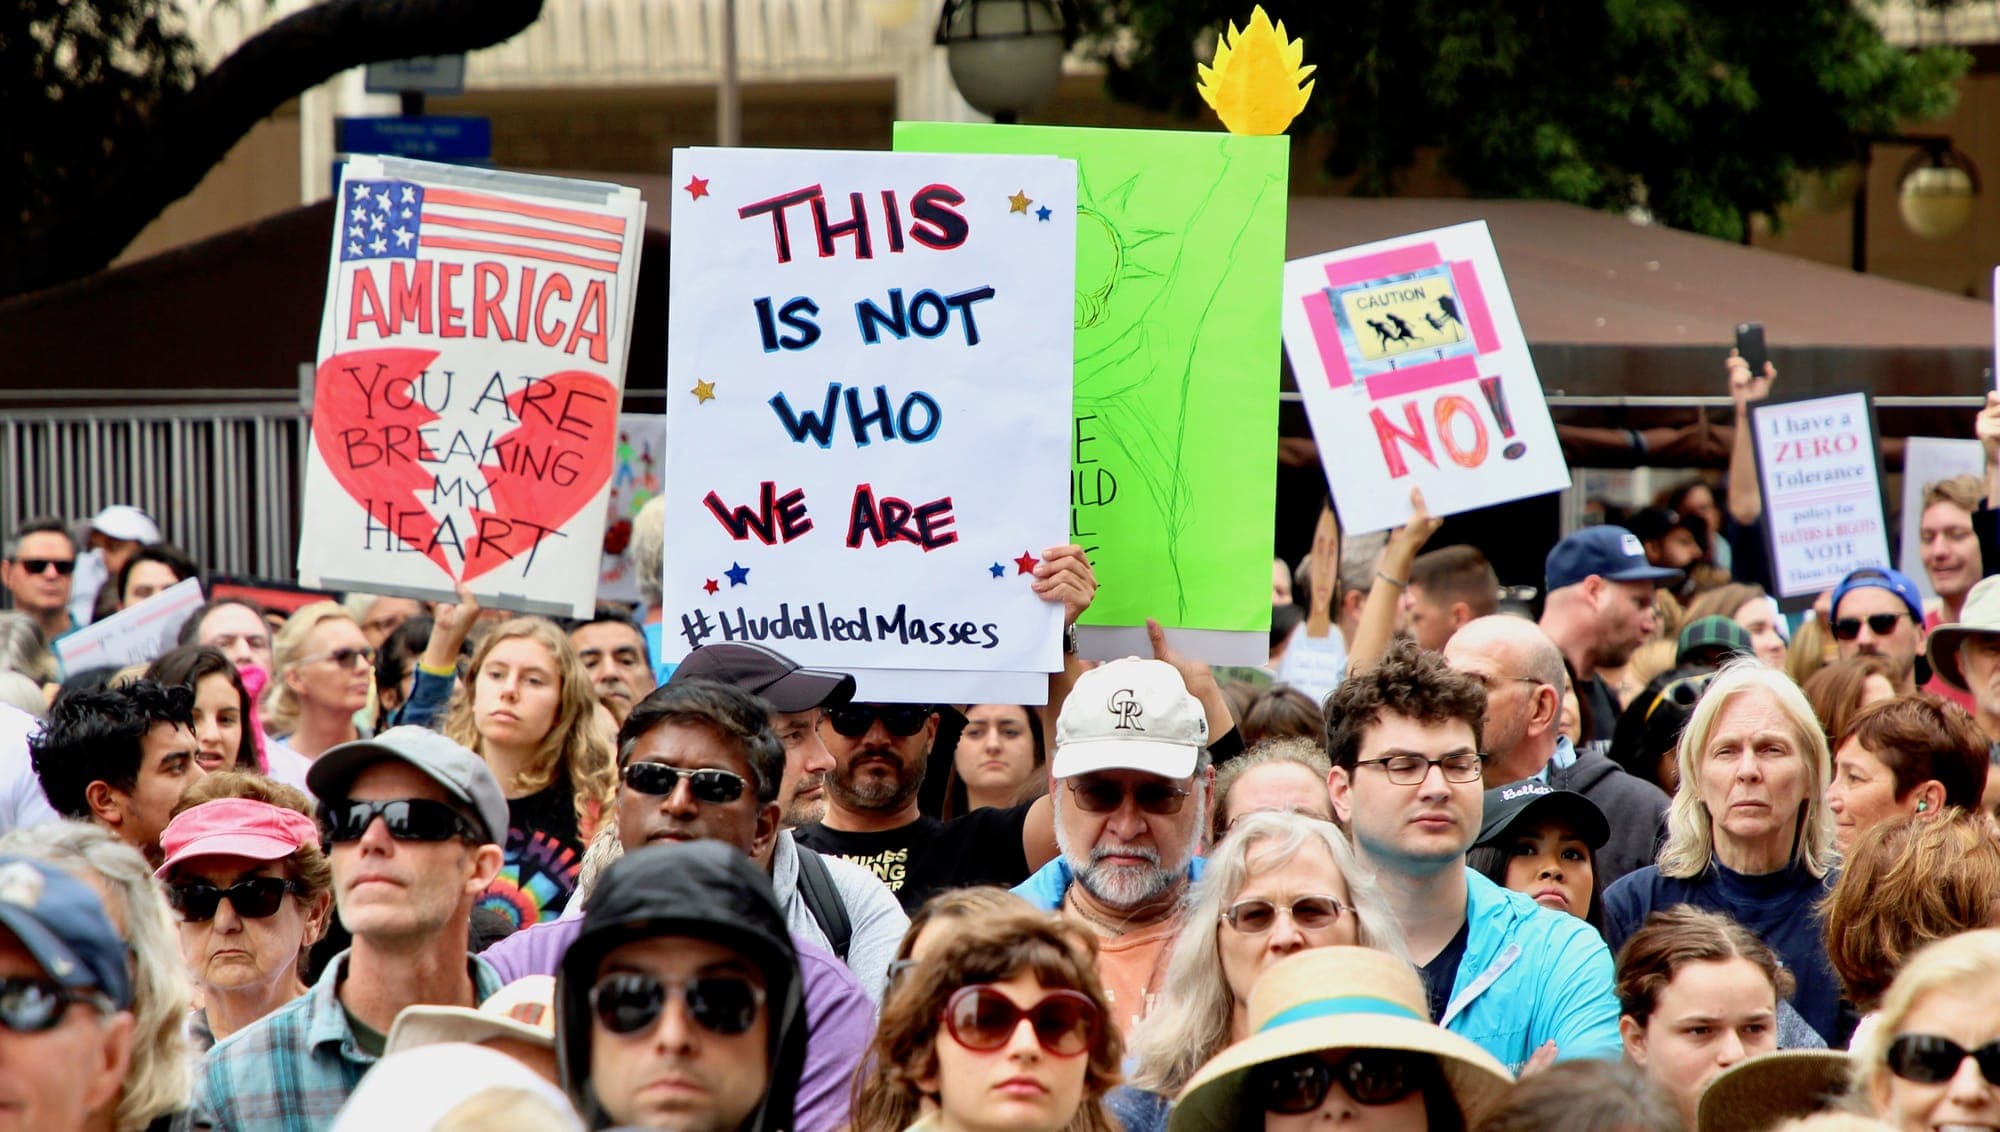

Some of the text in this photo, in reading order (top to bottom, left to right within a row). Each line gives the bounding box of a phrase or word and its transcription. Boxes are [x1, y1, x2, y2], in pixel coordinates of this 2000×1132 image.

[738, 183, 969, 263] THIS
[347, 260, 608, 363] AMERICA
[753, 285, 995, 353] IS NOT
[1356, 287, 1426, 311] CAUTION
[343, 363, 608, 440] YOU ARE
[768, 382, 943, 449] WHO
[1369, 375, 1527, 479] NO!
[1773, 412, 1851, 435] I have a
[339, 426, 585, 487] BREAKING
[1775, 431, 1858, 462] ZERO
[1775, 465, 1865, 489] Tolerance
[432, 475, 497, 512] MY
[703, 481, 958, 552] WE ARE
[1793, 503, 1854, 523] policy for
[364, 498, 568, 578] HEART
[1805, 541, 1853, 560] VOTE
[680, 602, 1000, 650] #HuddledMasses
